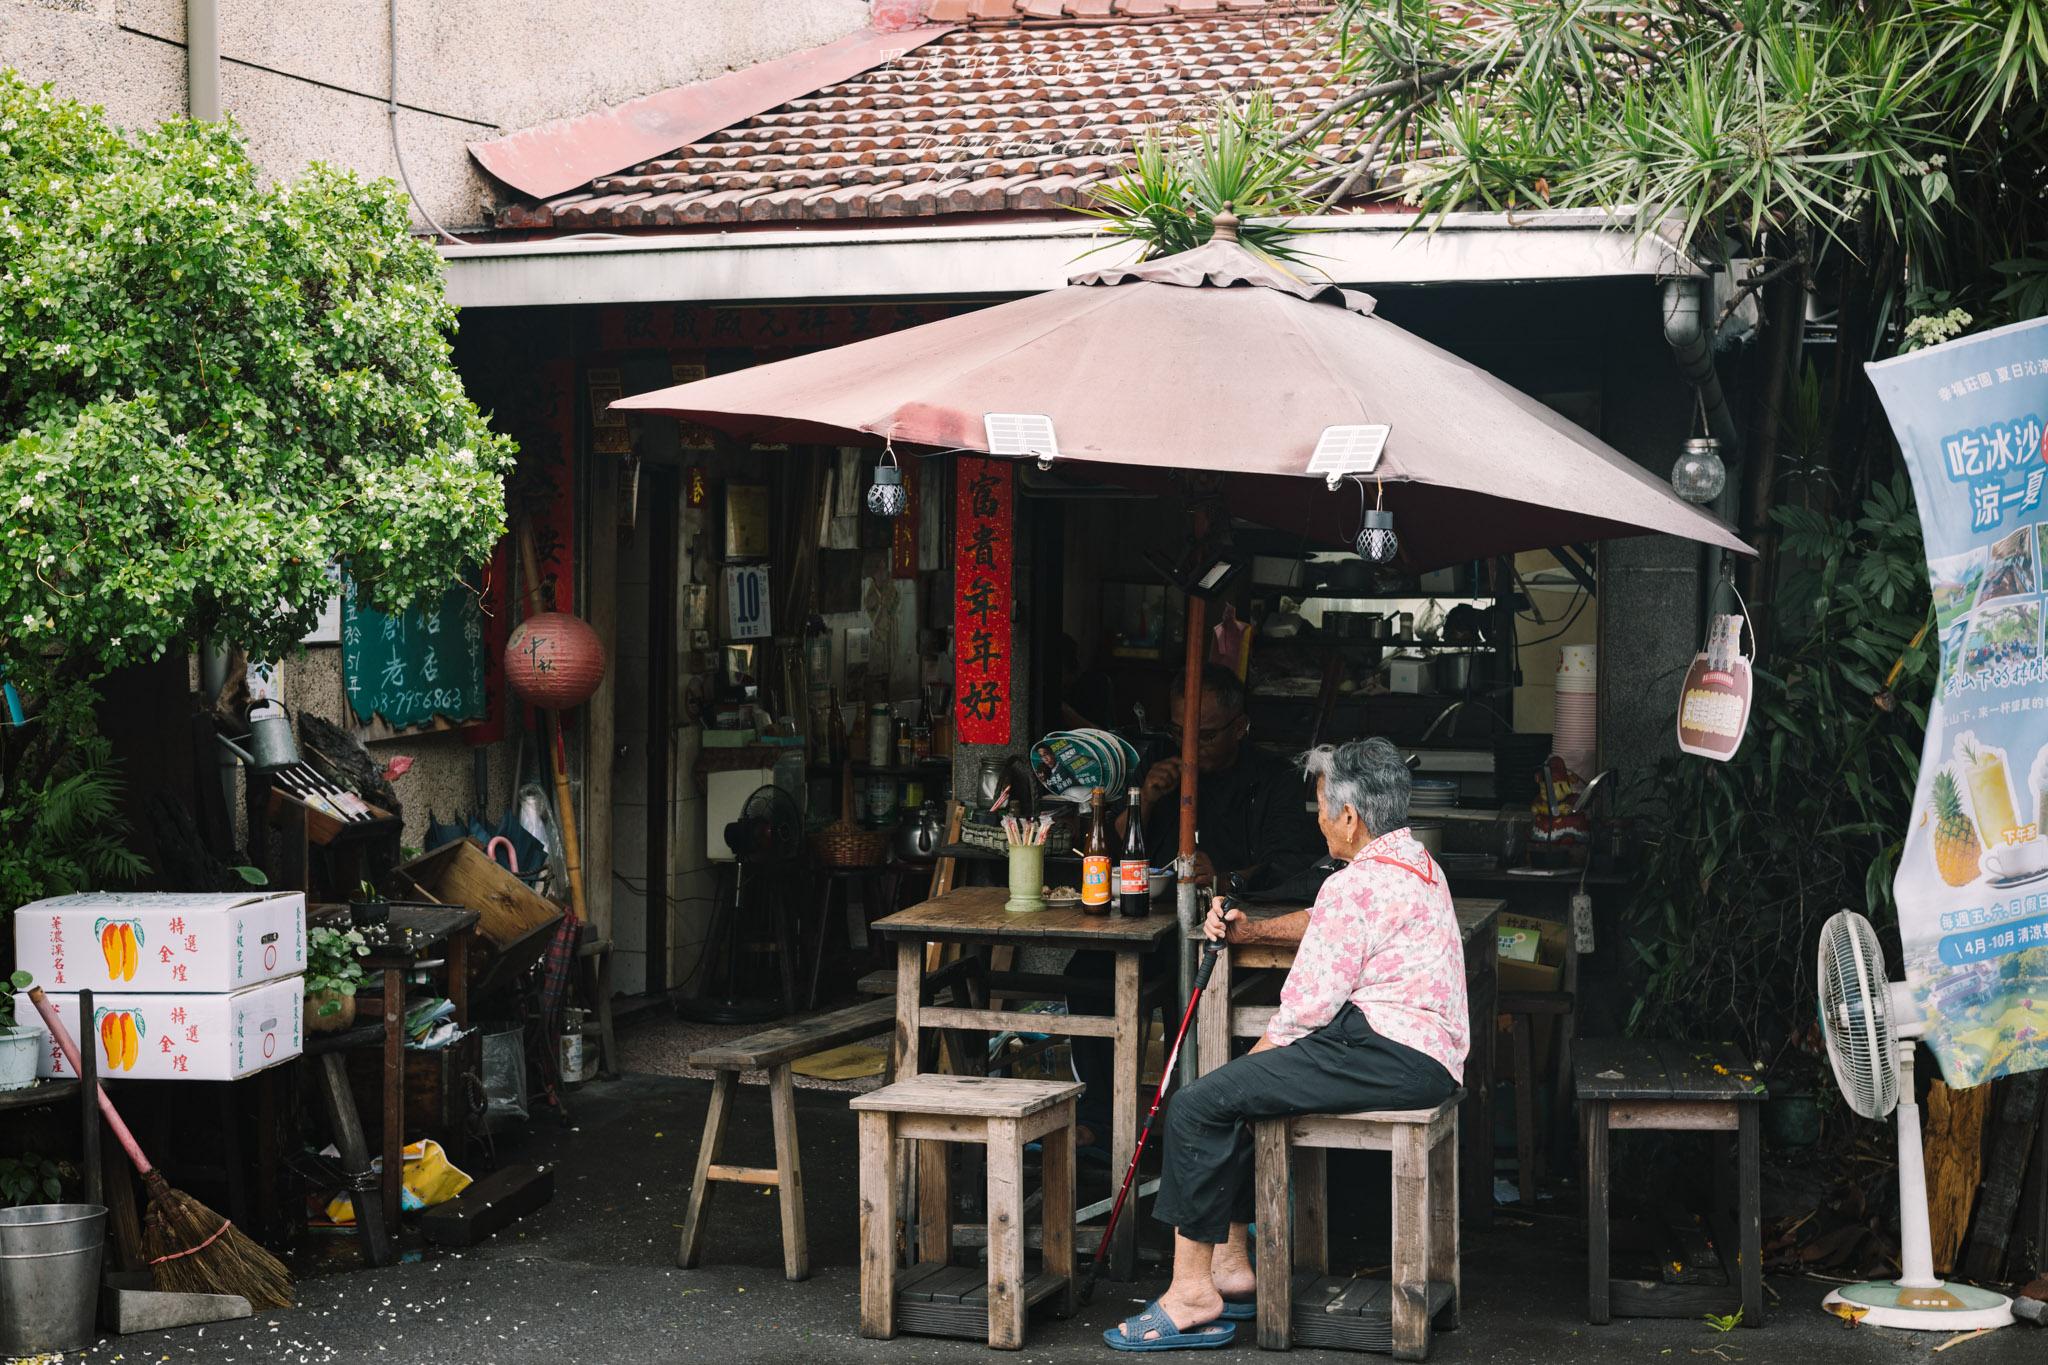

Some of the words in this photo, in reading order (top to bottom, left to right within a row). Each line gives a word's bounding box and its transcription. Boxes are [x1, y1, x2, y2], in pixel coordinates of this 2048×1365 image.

[1947, 420, 2041, 476] 吃冰沙
[1974, 466, 2046, 527] 涼一夏
[737, 572, 760, 623] 10
[2002, 823, 2037, 845] 下午茶
[168, 916, 199, 953] 特選
[158, 944, 189, 982] 金煌
[170, 1006, 200, 1043] 特選
[158, 1034, 189, 1072] 金煌
